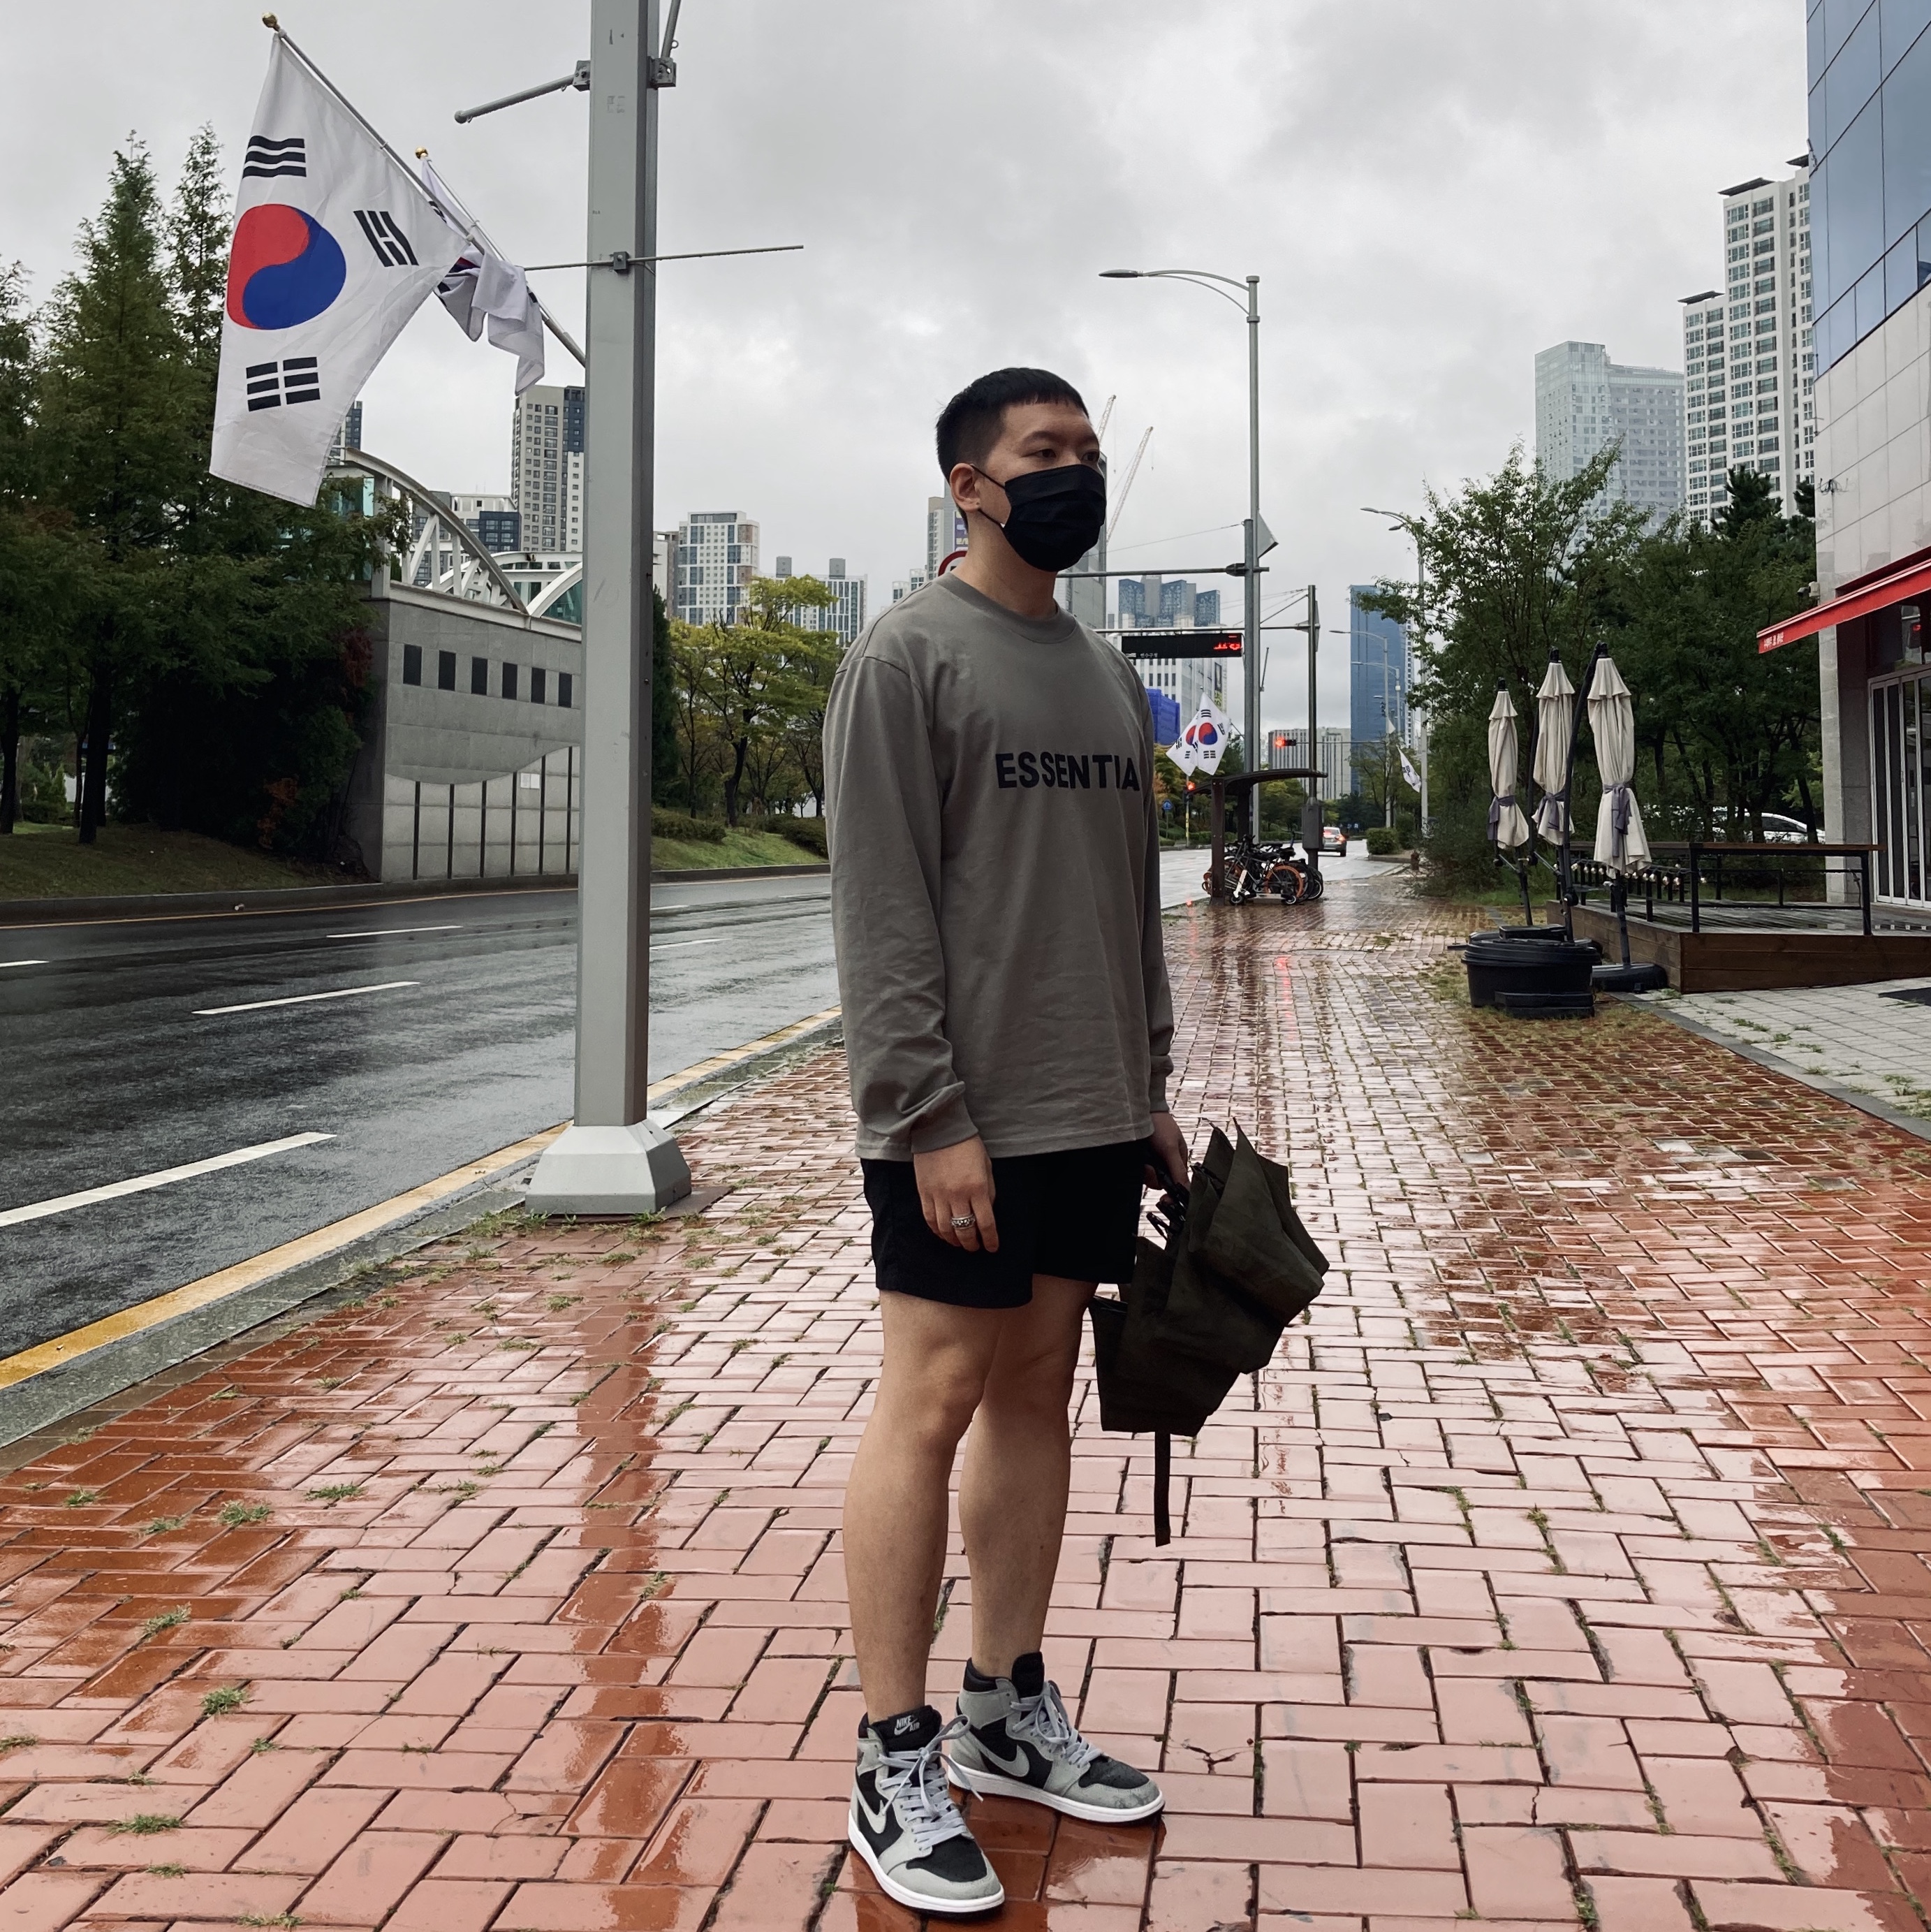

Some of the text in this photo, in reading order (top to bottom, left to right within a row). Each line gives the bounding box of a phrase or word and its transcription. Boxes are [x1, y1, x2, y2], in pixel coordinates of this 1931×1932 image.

[995, 751, 1140, 791] ESSENTIA
[896, 1715, 911, 1729] NIKE
[909, 1722, 920, 1732] AIR
